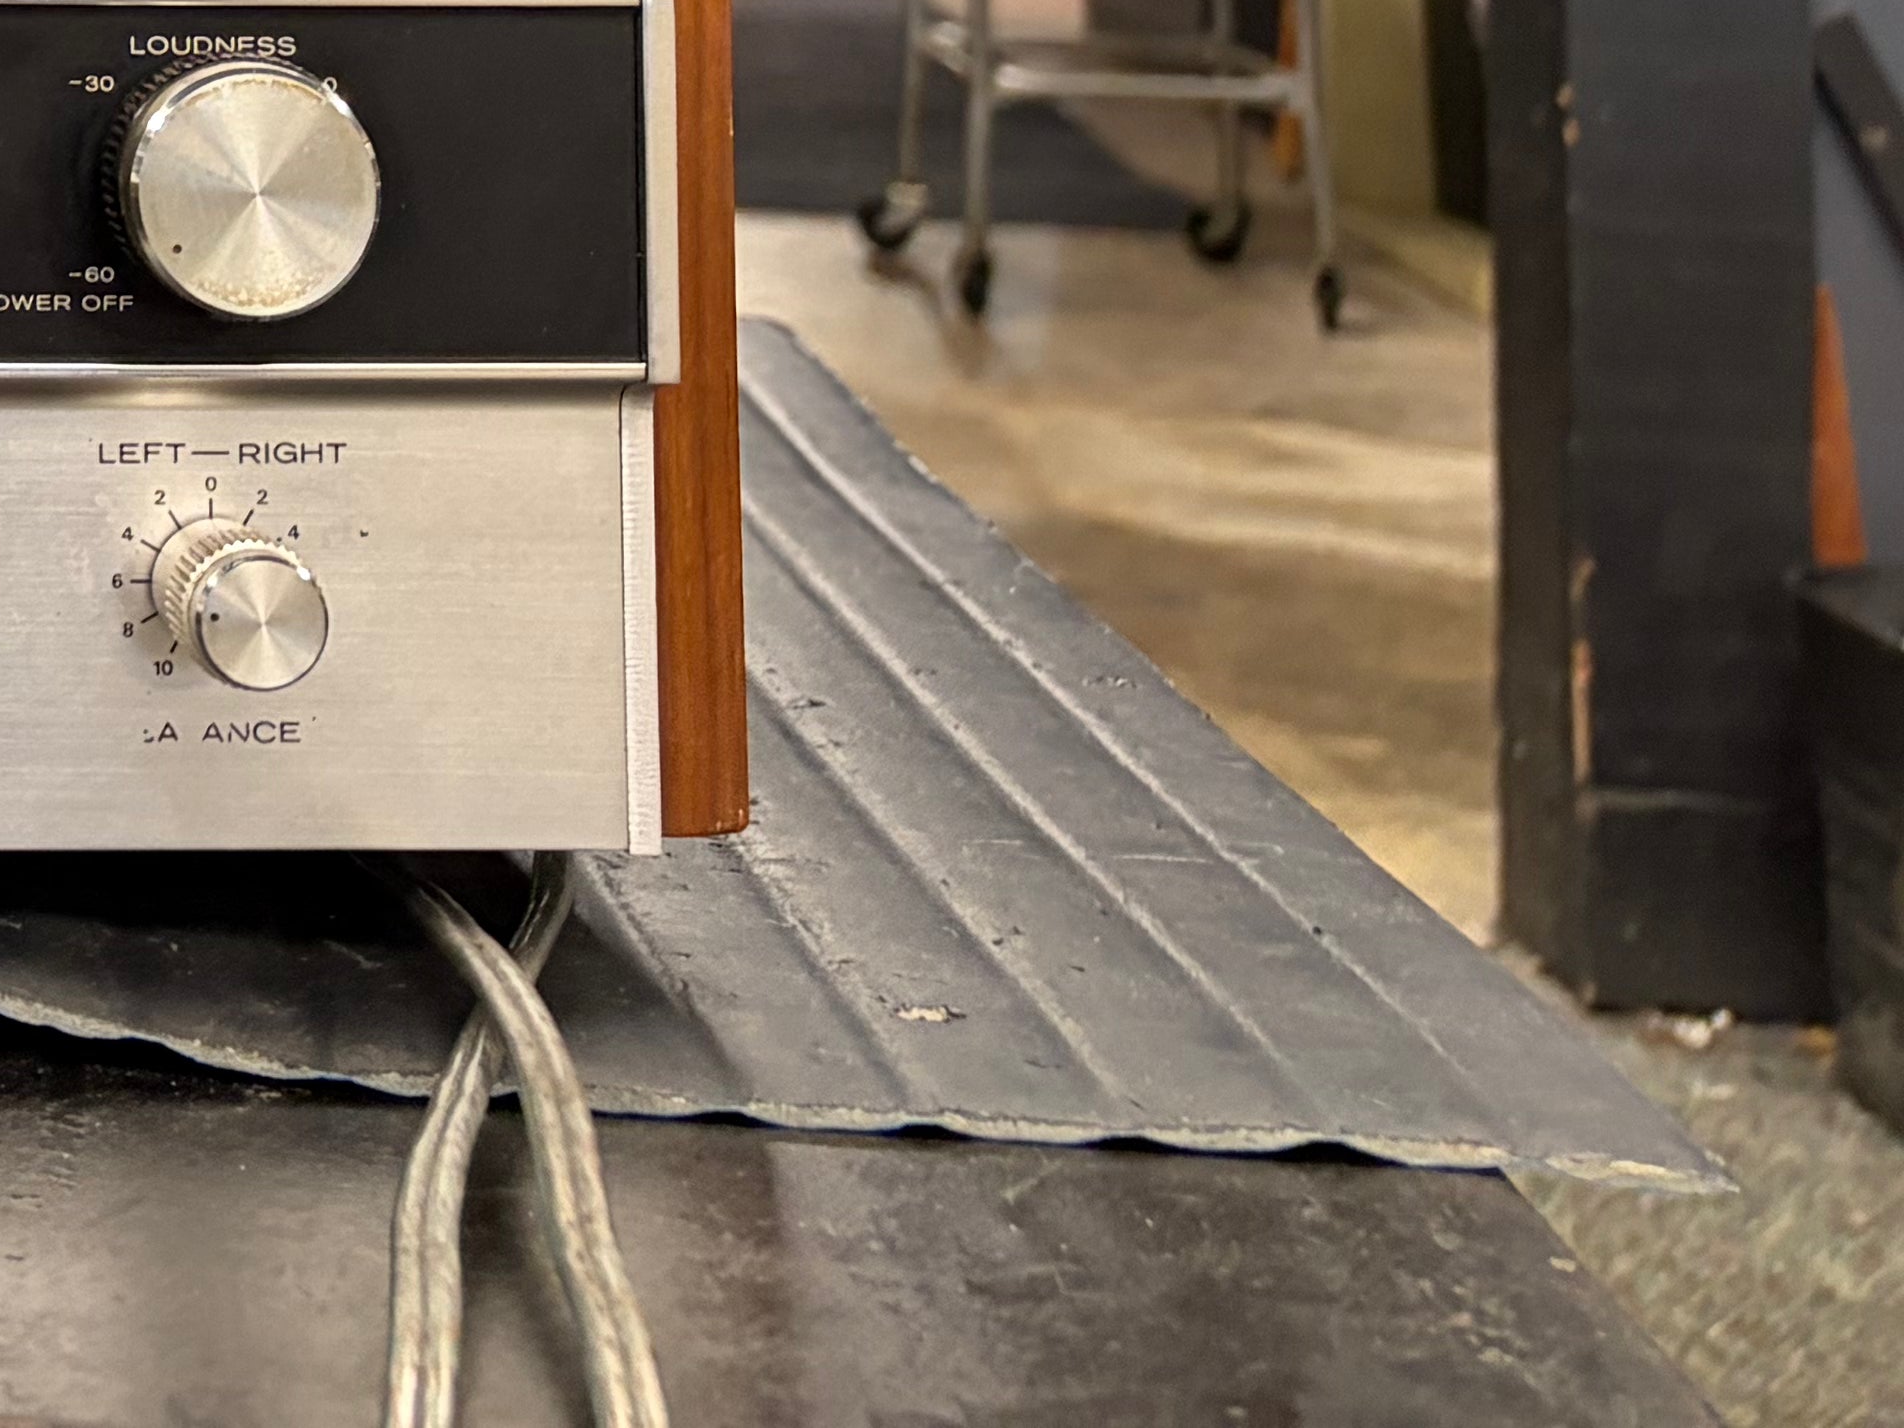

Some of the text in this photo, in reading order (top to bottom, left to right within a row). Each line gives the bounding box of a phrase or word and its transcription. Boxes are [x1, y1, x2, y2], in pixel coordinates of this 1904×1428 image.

[129, 36, 297, 56] LOUDNESS
[68, 75, 115, 93] -30
[68, 266, 115, 284] -60
[82, 293, 134, 313] OFF
[154, 490, 166, 505] 2
[256, 490, 269, 505] 2
[122, 527, 134, 541] 4
[287, 525, 300, 540] 4
[111, 573, 123, 588] 6
[123, 622, 134, 638] 8
[153, 660, 174, 676] 10
[143, 721, 301, 744] AANCE
